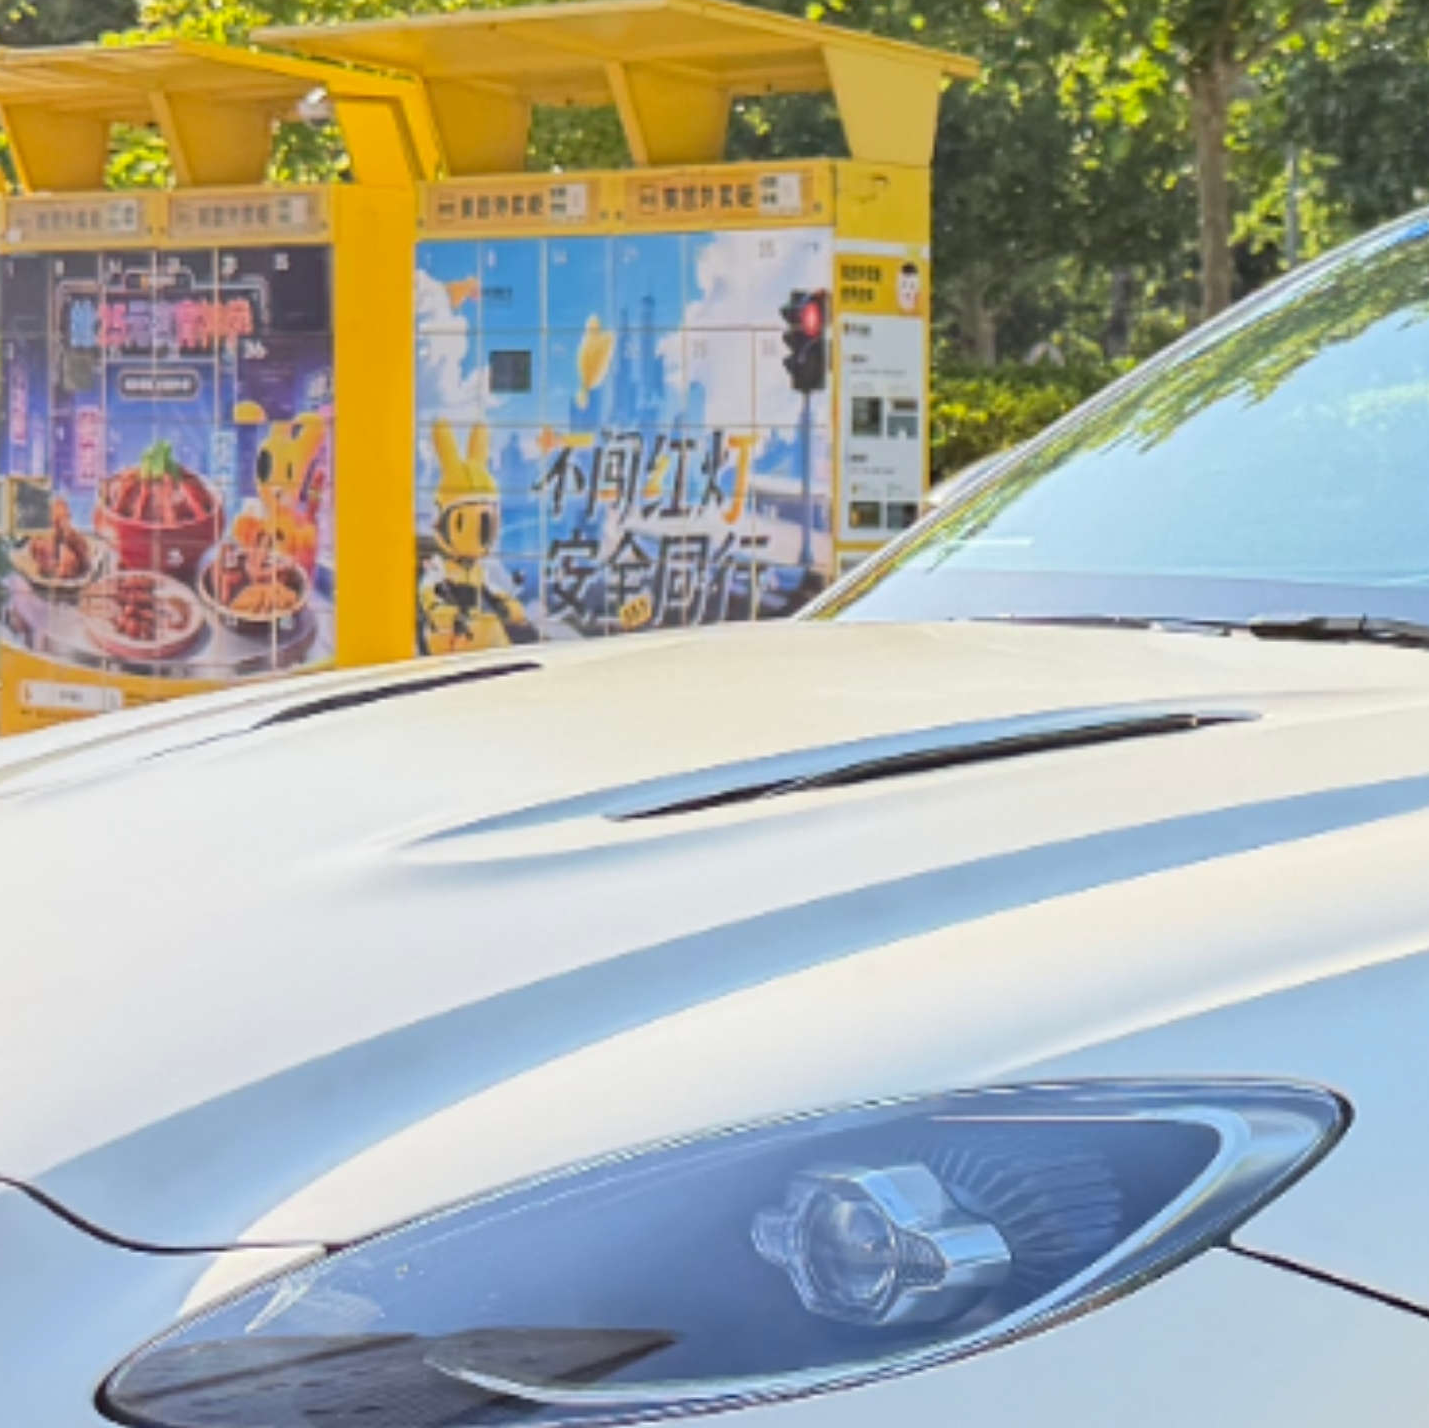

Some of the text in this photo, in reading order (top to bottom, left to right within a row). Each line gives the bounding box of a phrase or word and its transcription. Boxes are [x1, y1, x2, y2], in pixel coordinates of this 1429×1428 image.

[530, 427, 759, 526] 不闯红灯
[544, 529, 771, 638] 安全同行
